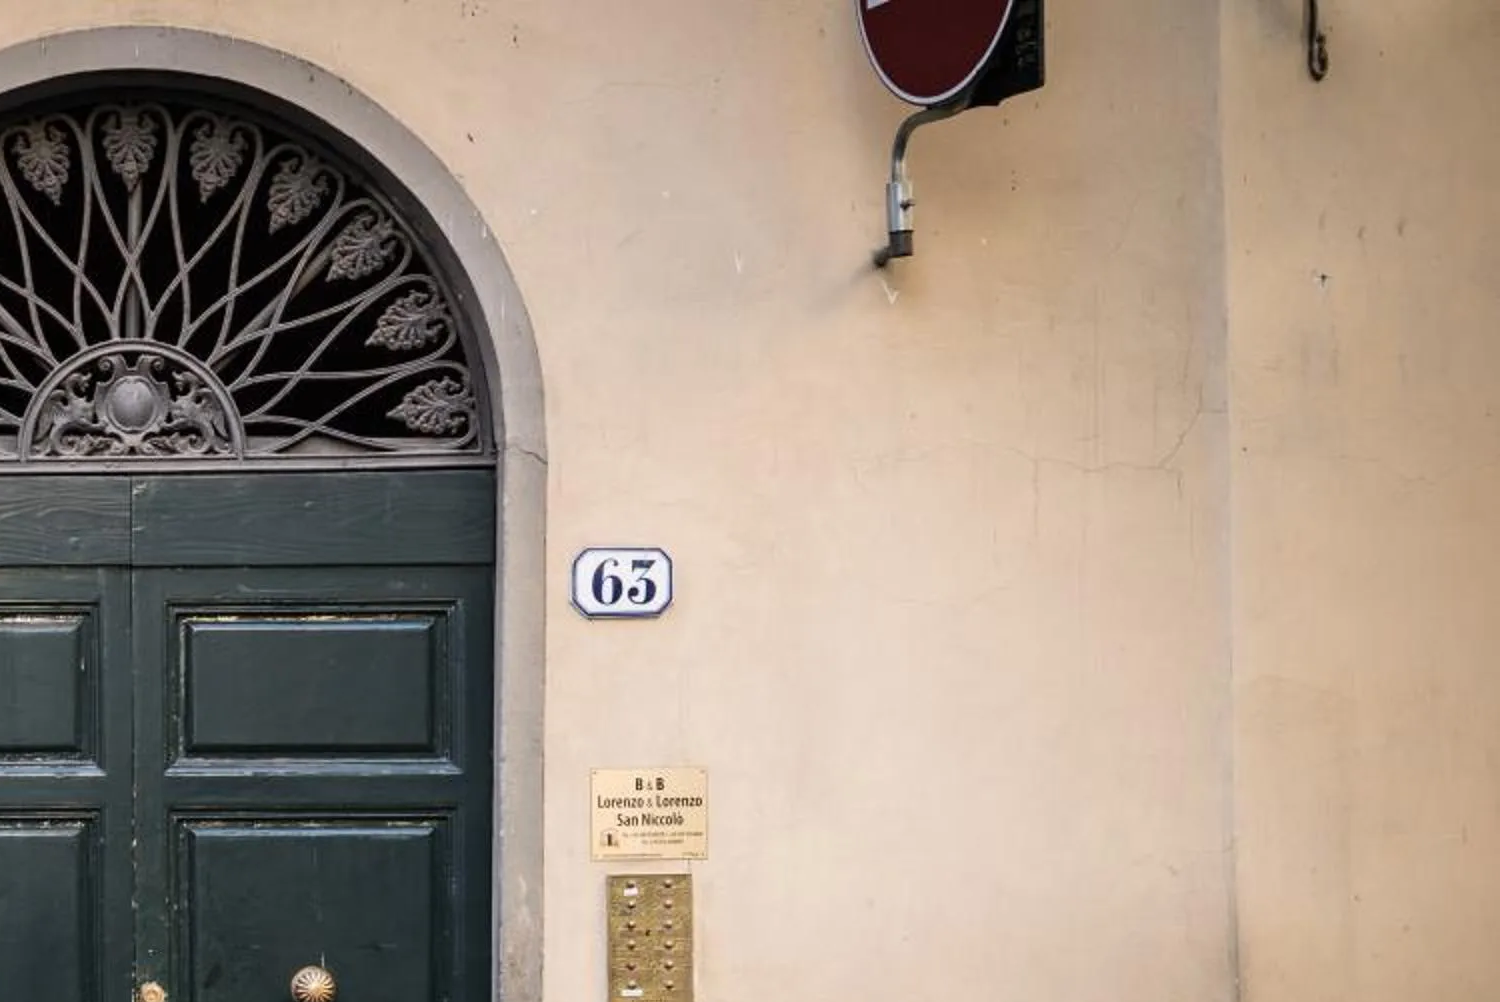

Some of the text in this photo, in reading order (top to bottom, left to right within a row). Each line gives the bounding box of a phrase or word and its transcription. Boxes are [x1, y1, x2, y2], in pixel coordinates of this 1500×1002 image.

[592, 557, 657, 606] 63
[635, 777, 643, 791] B
[655, 777, 665, 791] B
[597, 795, 644, 809] Lorenzo
[655, 795, 703, 808] Lorenzo
[616, 813, 639, 827] San
